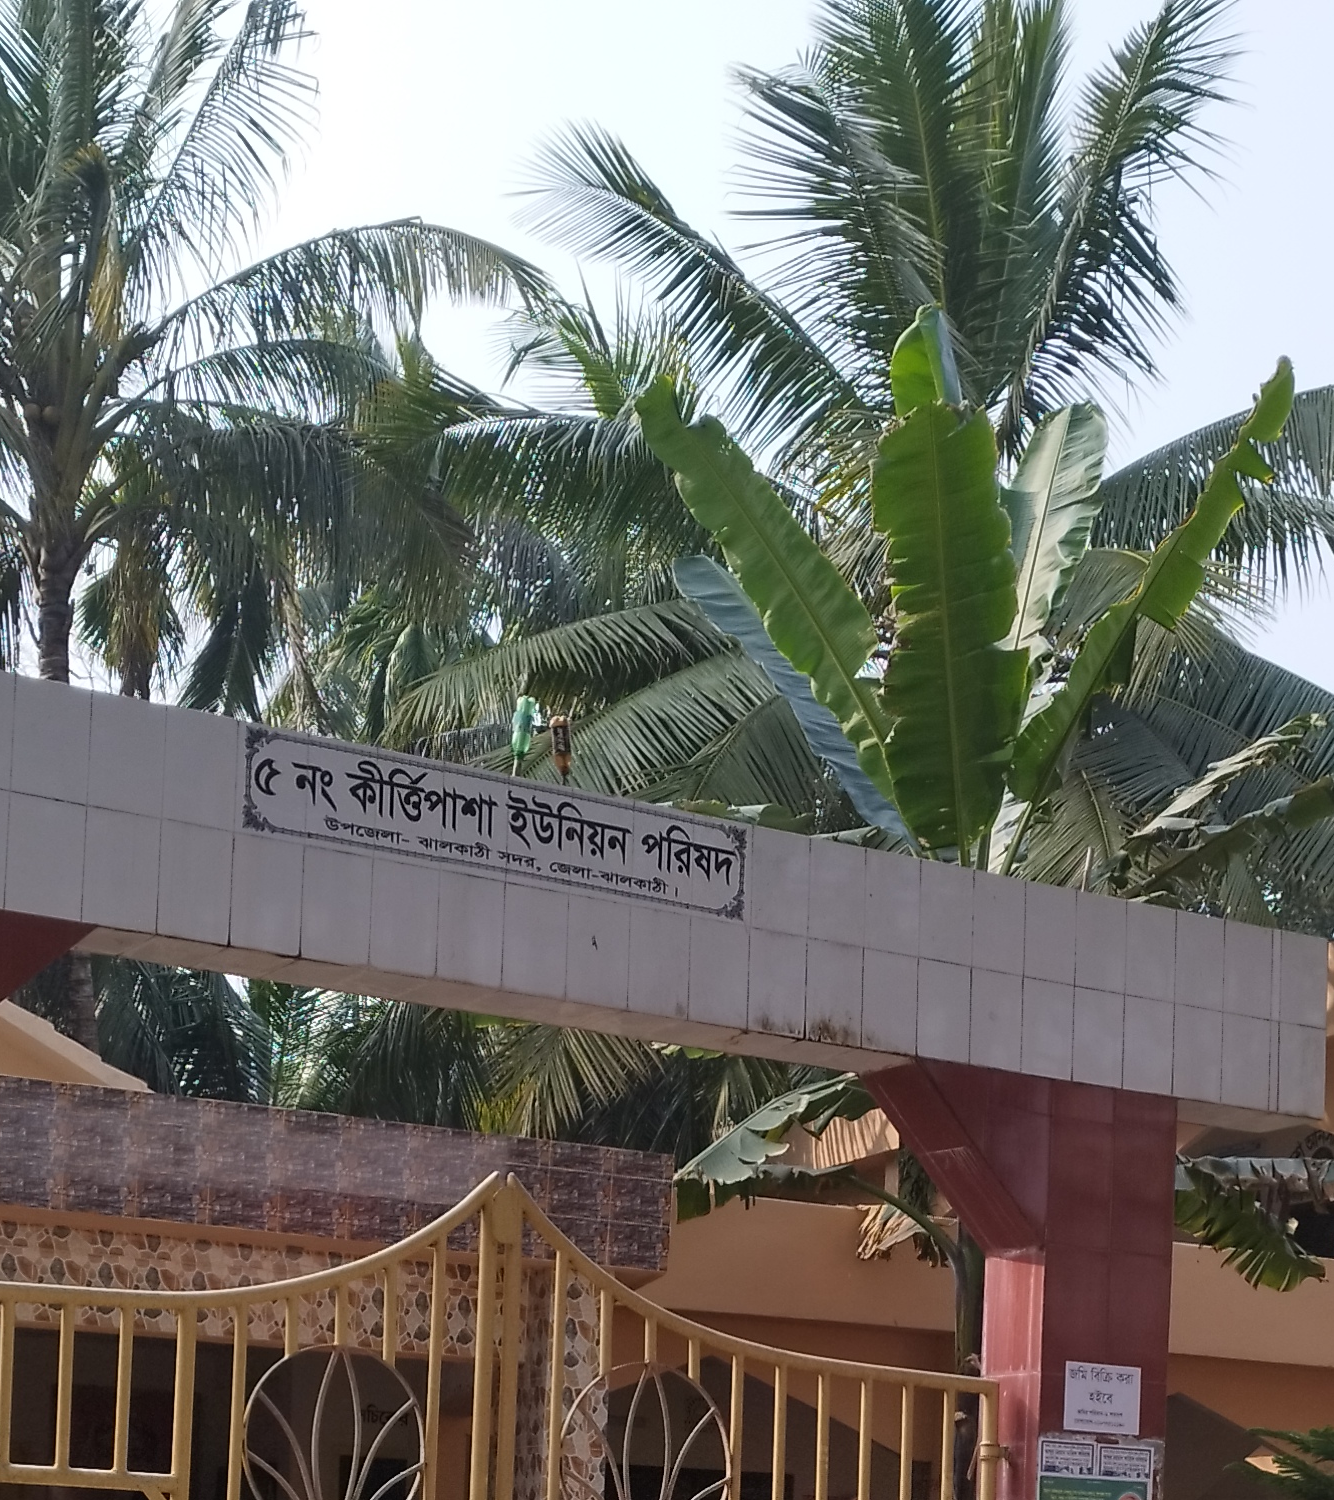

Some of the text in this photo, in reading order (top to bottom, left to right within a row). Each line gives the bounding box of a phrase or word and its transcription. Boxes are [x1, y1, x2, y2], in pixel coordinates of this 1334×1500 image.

[254, 757, 736, 887] ৫ নং কীর্ত্তিপাশা ইউনিয়ন পরিষদ
[417, 835, 493, 860] ঝালকাঠী
[497, 850, 541, 871] সদর,
[1069, 1365, 1134, 1385] জমি বিক্রি করা
[1088, 1390, 1114, 1405] হইবে
